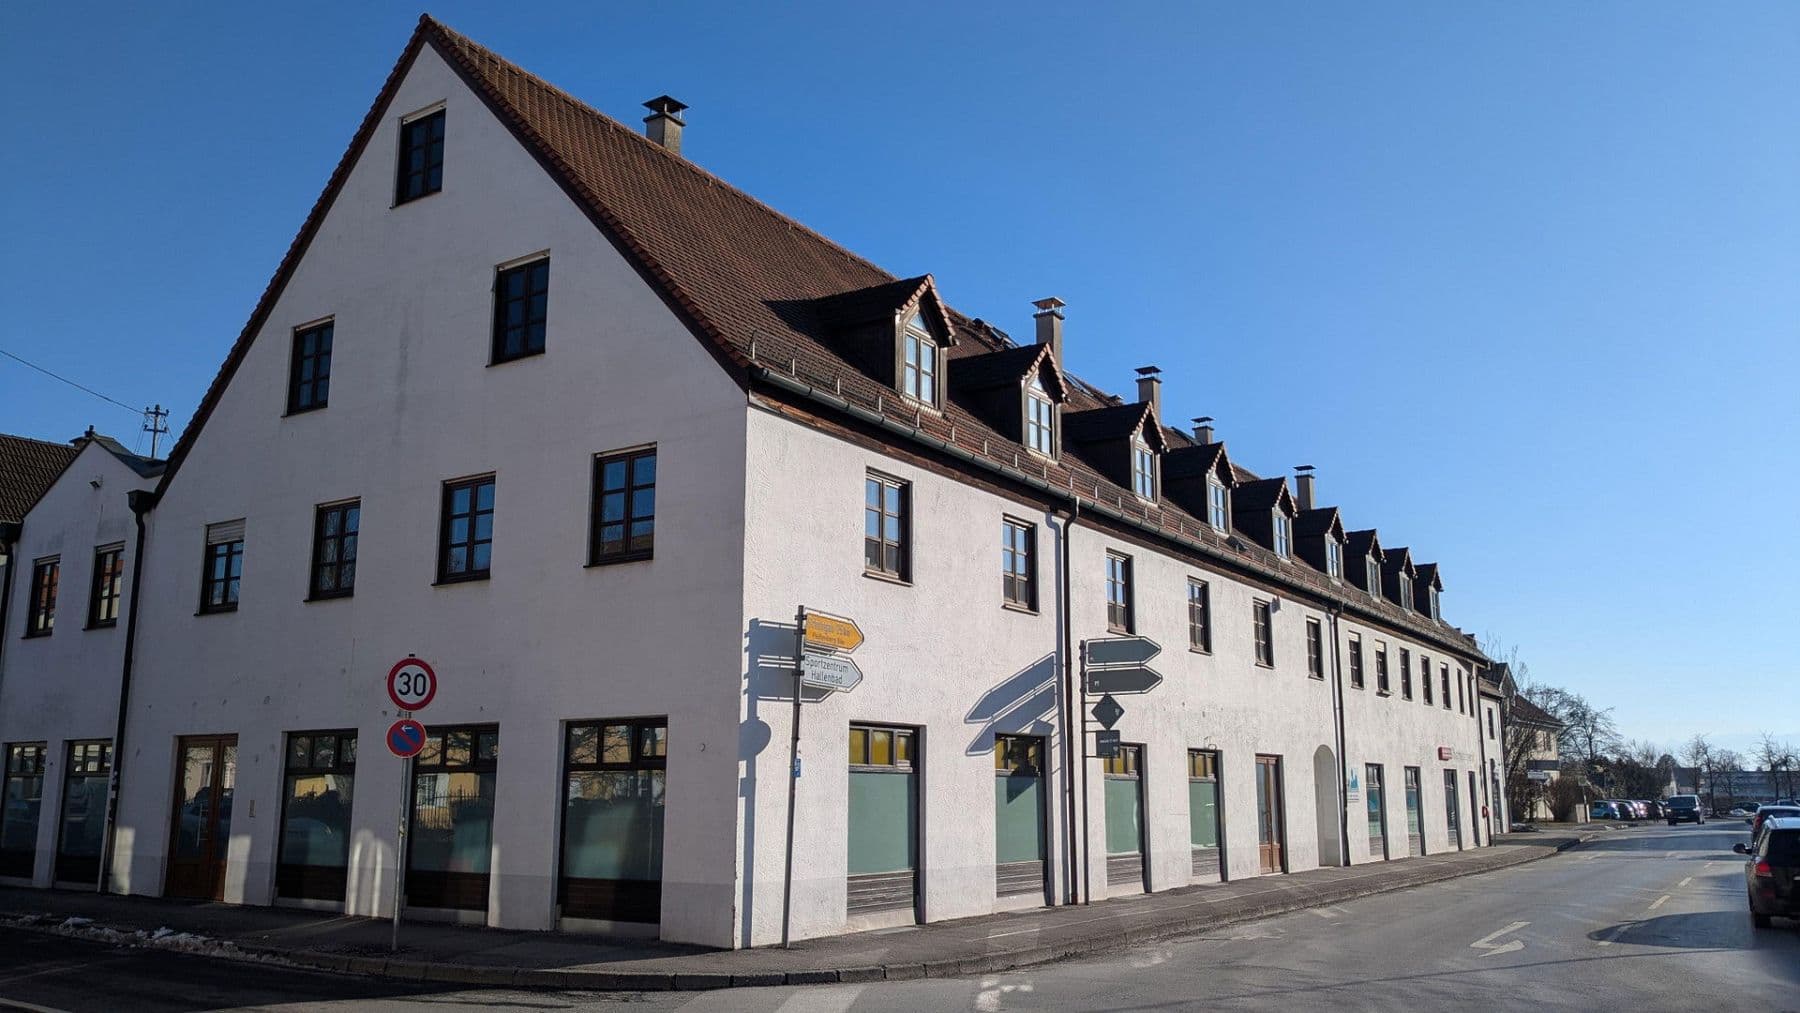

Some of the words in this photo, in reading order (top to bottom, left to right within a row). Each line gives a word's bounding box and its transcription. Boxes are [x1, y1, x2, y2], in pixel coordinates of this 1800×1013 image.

[805, 656, 848, 672] Sportzentrum
[399, 672, 426, 696] 30
[811, 670, 843, 684] Hallenbad
